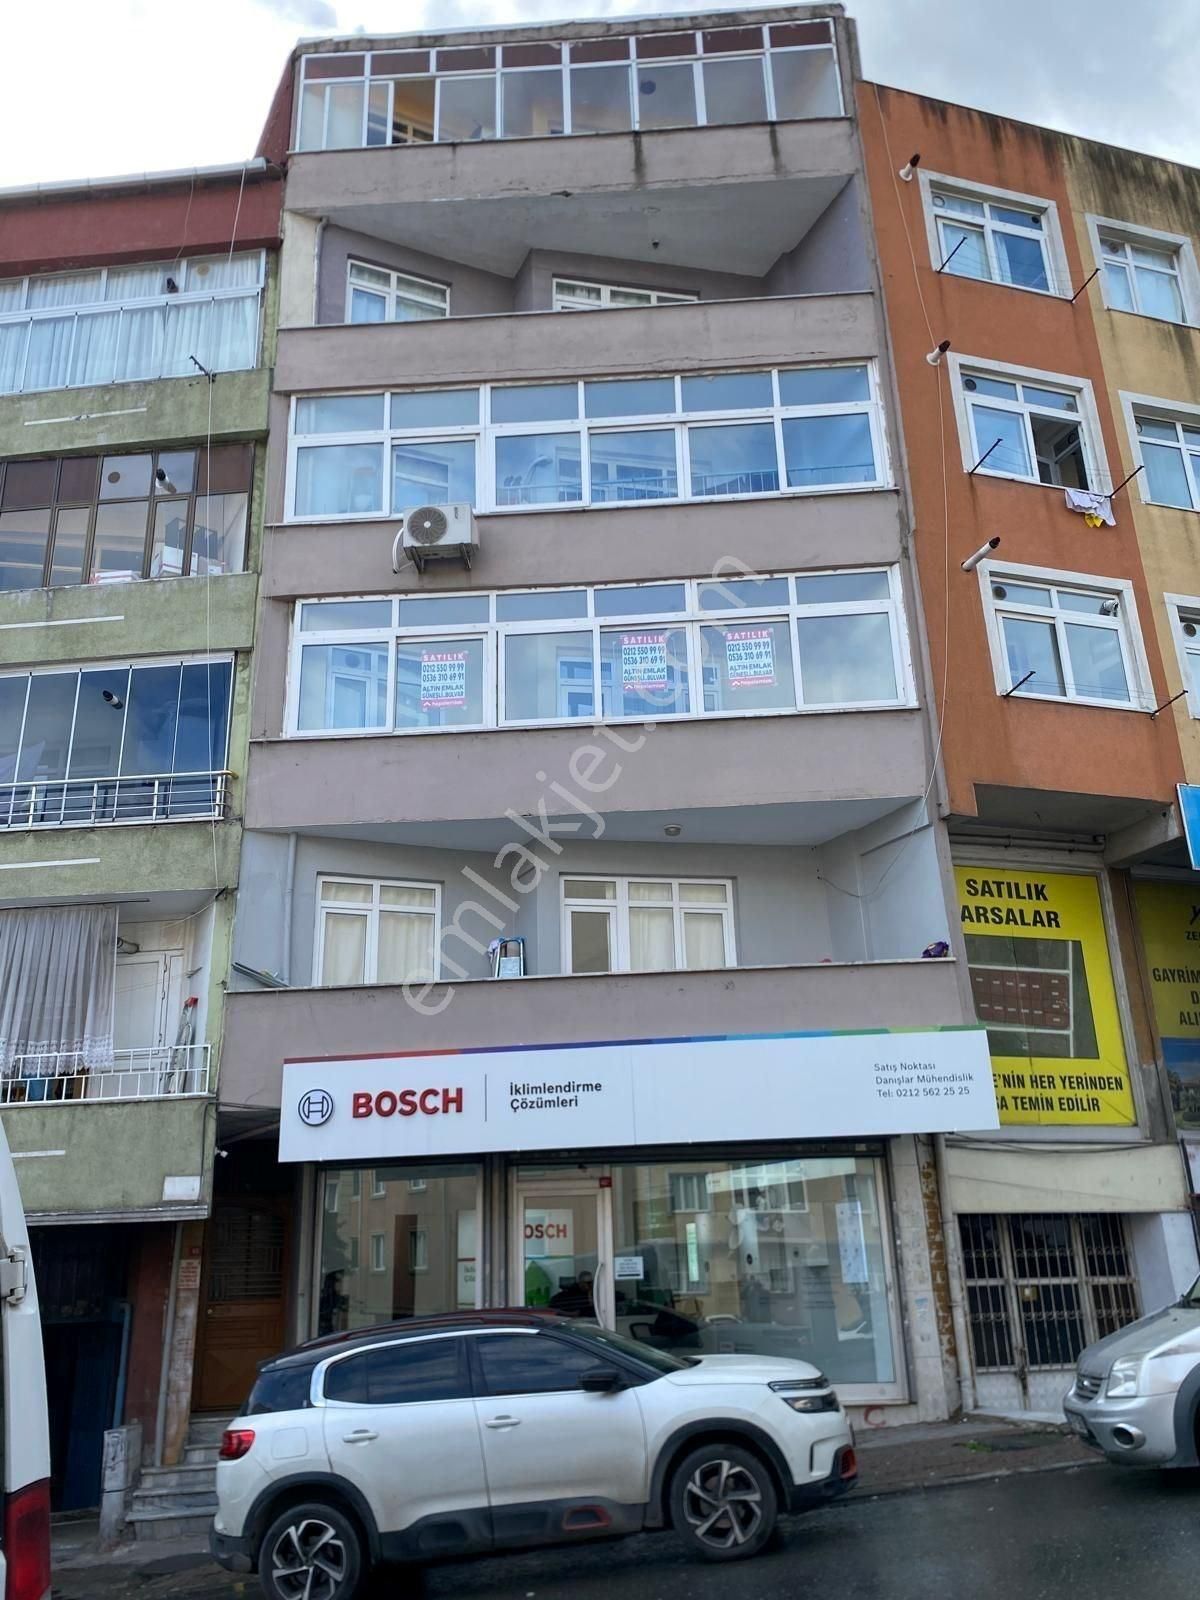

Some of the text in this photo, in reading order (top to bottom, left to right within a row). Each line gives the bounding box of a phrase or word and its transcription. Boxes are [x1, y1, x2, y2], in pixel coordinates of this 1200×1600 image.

[623, 635, 665, 644] SATILIK
[727, 630, 769, 640] SATILIK
[623, 645, 666, 656] 0212 550 99 99
[727, 640, 770, 652] 0212 550 99 99
[423, 653, 464, 661] SATILIK
[623, 655, 666, 665] 0536 310 69 91
[728, 650, 771, 662] 0536 310 69 91
[423, 662, 464, 673] 0212 550 99 99
[643, 666, 666, 674] EMLAK
[748, 662, 772, 670] EMLAK
[423, 672, 464, 682] 0536 310 69 91
[965, 878, 1048, 901] SATILIK
[961, 904, 1061, 928] ARSALAR
[874, 1061, 936, 1072] Satış Noktası
[875, 1073, 974, 1085] Danışlar Mühendislik
[1030, 1074, 1056, 1089] HER
[1060, 1072, 1124, 1091] YERİNDEN
[509, 1081, 602, 1096] İklimlendirme
[877, 1086, 970, 1098] Tel: 0212 562 25 25
[352, 1087, 463, 1118] BOSCH
[510, 1095, 578, 1113] Çözümleri
[1012, 1092, 1055, 1111] TEMİN
[1059, 1093, 1101, 1112] EDİLİR
